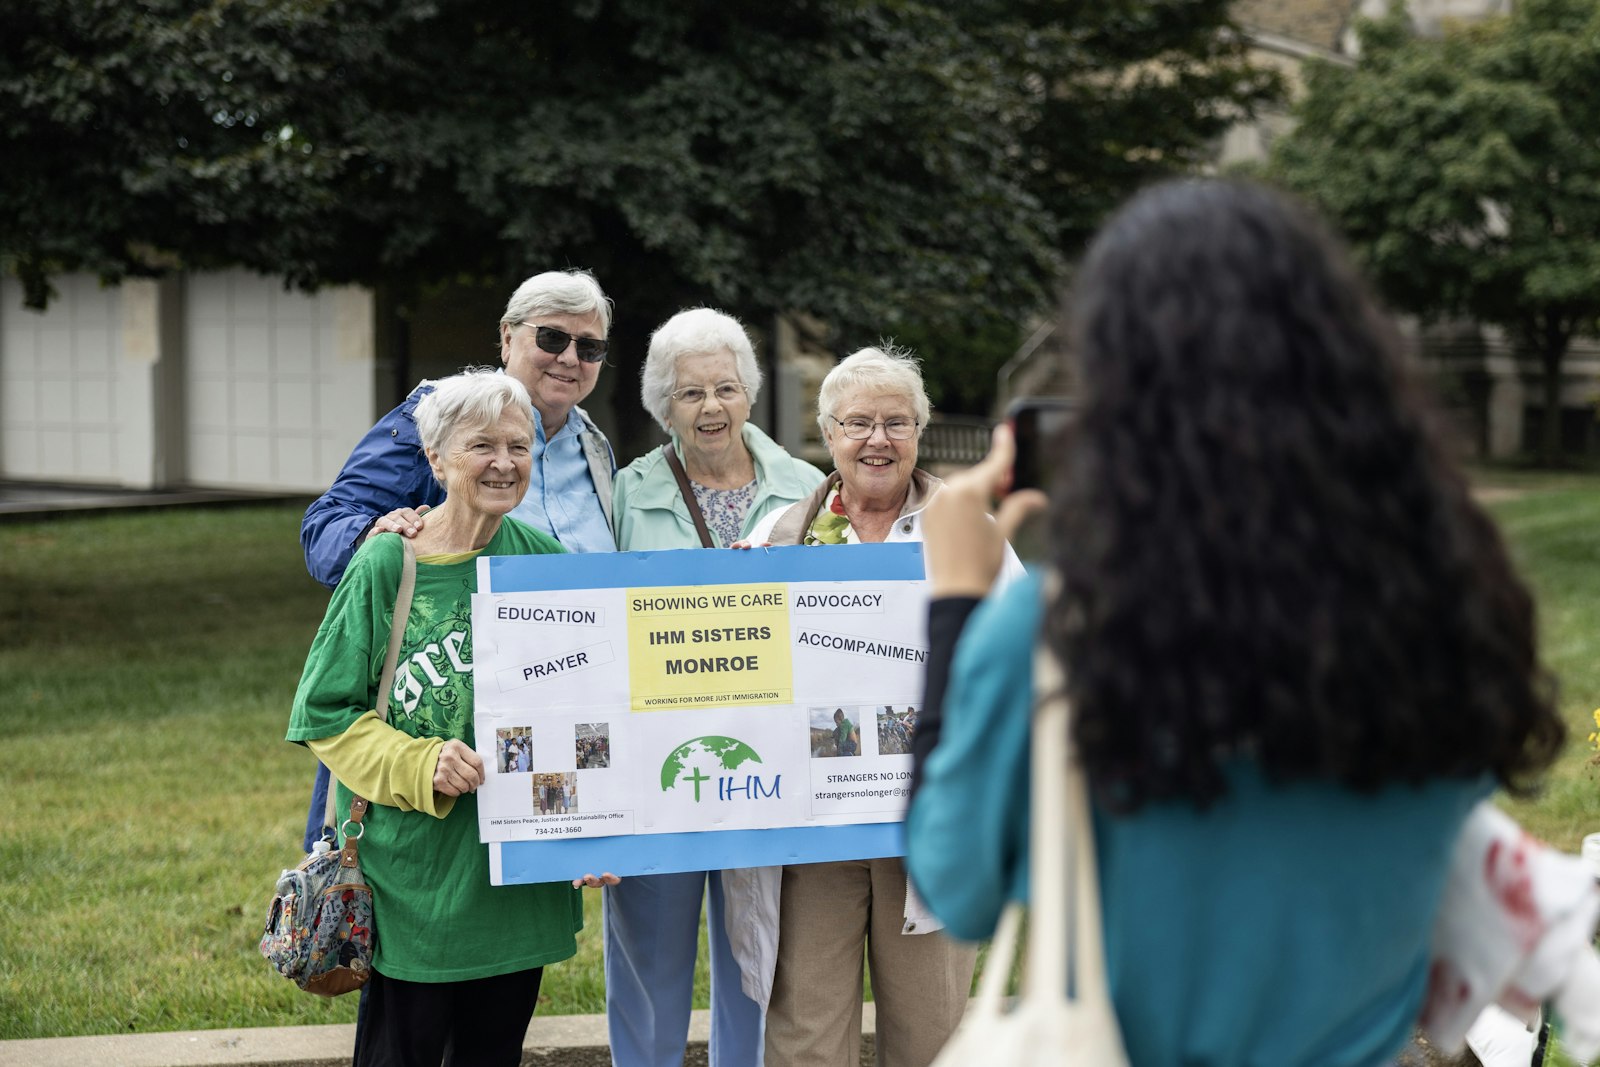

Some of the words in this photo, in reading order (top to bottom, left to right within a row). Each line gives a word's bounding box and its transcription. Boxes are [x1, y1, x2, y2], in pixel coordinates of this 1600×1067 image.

[633, 597, 709, 612] SHOWING
[712, 595, 738, 608] WE
[741, 593, 783, 607] CARE
[796, 595, 882, 608] ADVOCACY
[497, 607, 596, 624] EDUCATION
[649, 631, 686, 645] IHM
[691, 627, 771, 643] SISTERS
[523, 652, 589, 681] PRAYER
[666, 656, 759, 675] MONROE
[645, 698, 678, 706] WORKING
[694, 695, 714, 703] MORE
[716, 694, 730, 702] JUST
[732, 692, 779, 701] IMMIGRATION
[827, 773, 878, 783] STRANGERS
[881, 772, 893, 780] NO
[896, 772, 912, 780] LON
[718, 774, 782, 801] IHM
[572, 814, 607, 822] Sustainability
[535, 826, 582, 835] 734-241-3660
